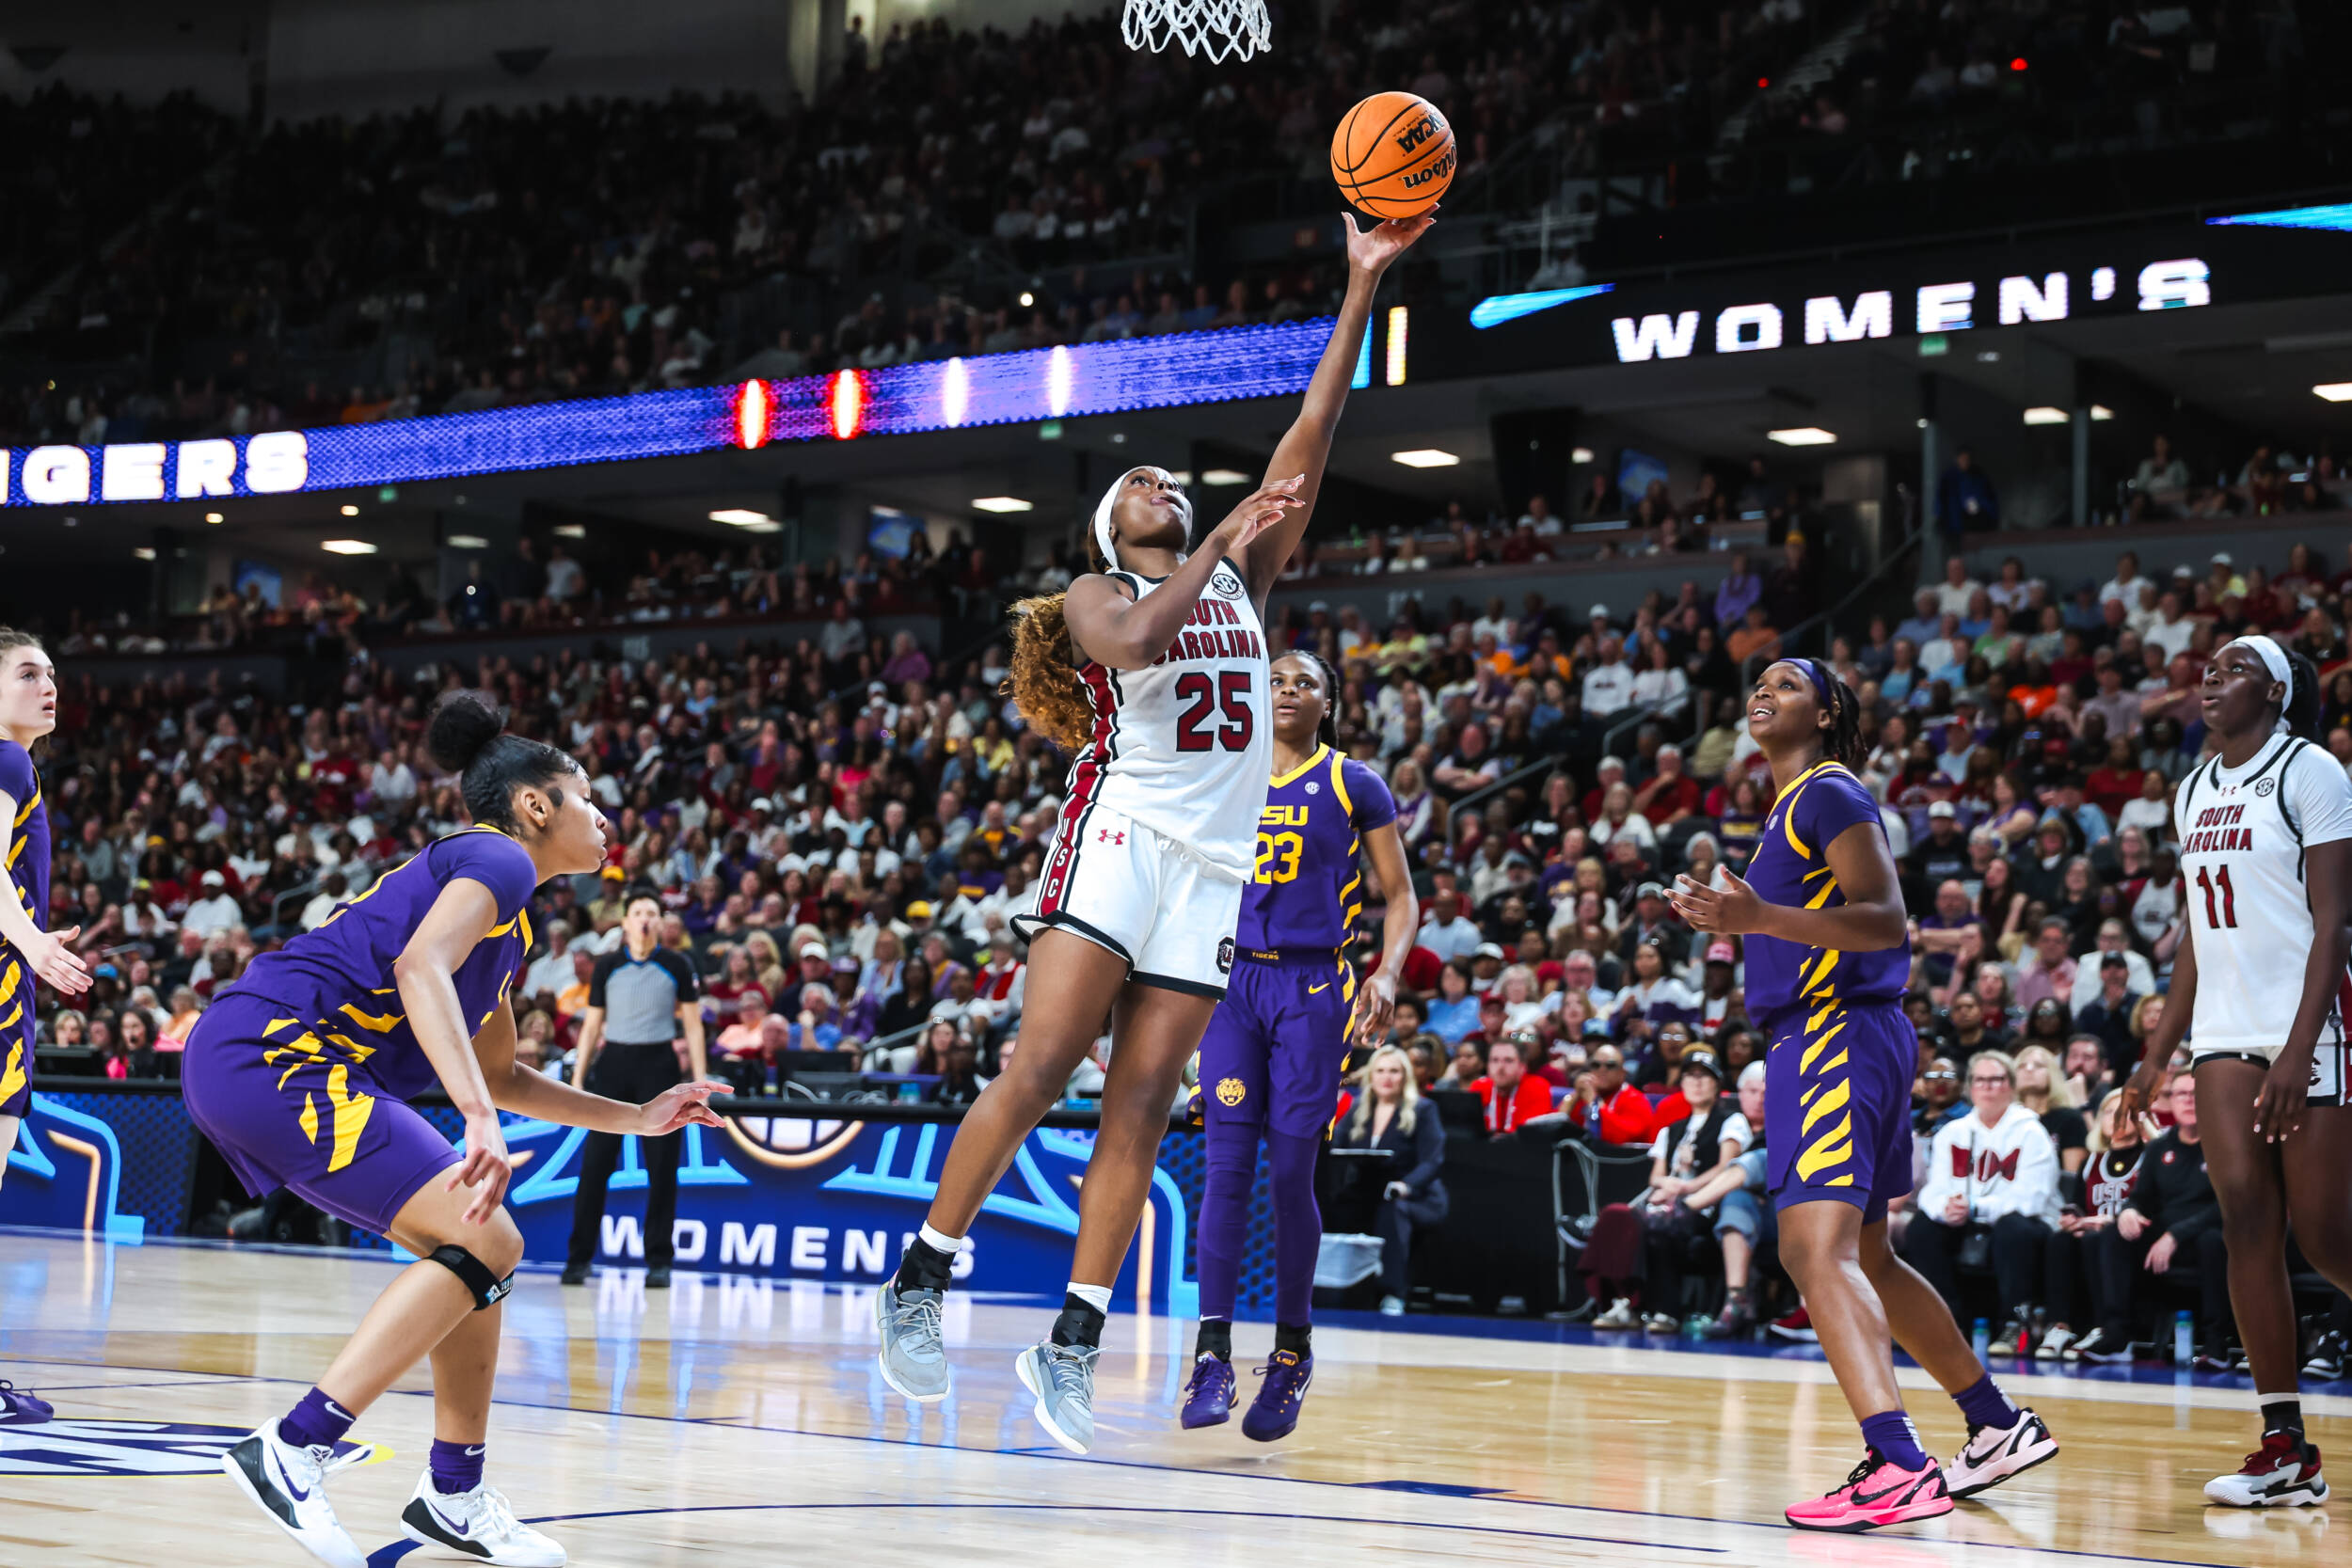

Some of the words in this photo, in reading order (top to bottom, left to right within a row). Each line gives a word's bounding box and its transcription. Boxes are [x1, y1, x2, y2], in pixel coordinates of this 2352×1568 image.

[1612, 258, 2210, 363] WOMEN'S
[1175, 671, 1253, 752] 25
[1260, 805, 1309, 826] SU
[2195, 804, 2246, 828] SOUTH
[1254, 831, 1303, 884] 23
[2197, 864, 2238, 929] 11
[1251, 951, 1279, 960] TIGERS
